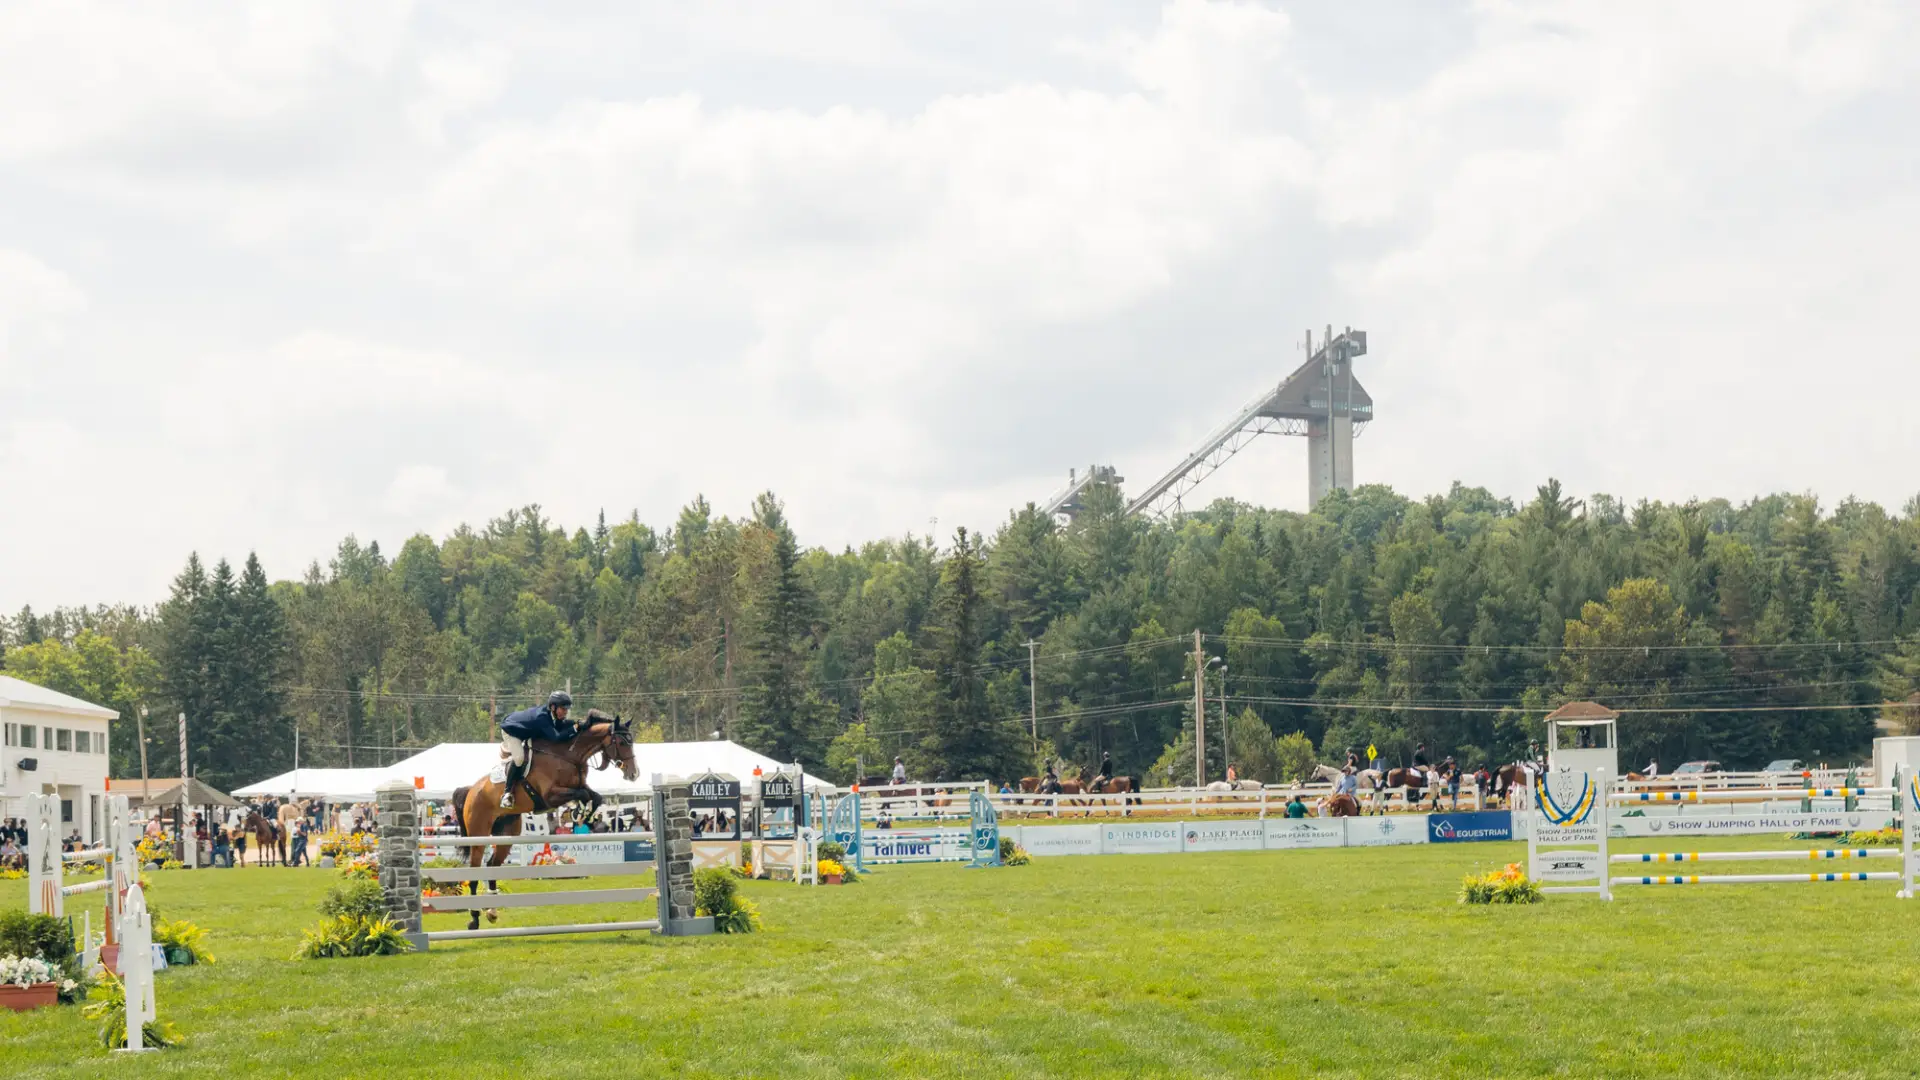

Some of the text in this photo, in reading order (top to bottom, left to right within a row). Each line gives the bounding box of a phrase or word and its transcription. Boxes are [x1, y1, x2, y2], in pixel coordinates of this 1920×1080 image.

[692, 783, 731, 796] KADLEY
[1668, 817, 1842, 830] SHOW JUMPING HALL OF FAME
[1202, 829, 1263, 839] LAKE PLACID
[1456, 828, 1508, 838] EQUESTRIAN
[1536, 828, 1561, 836] SHOW
[591, 843, 623, 852] PLACID
